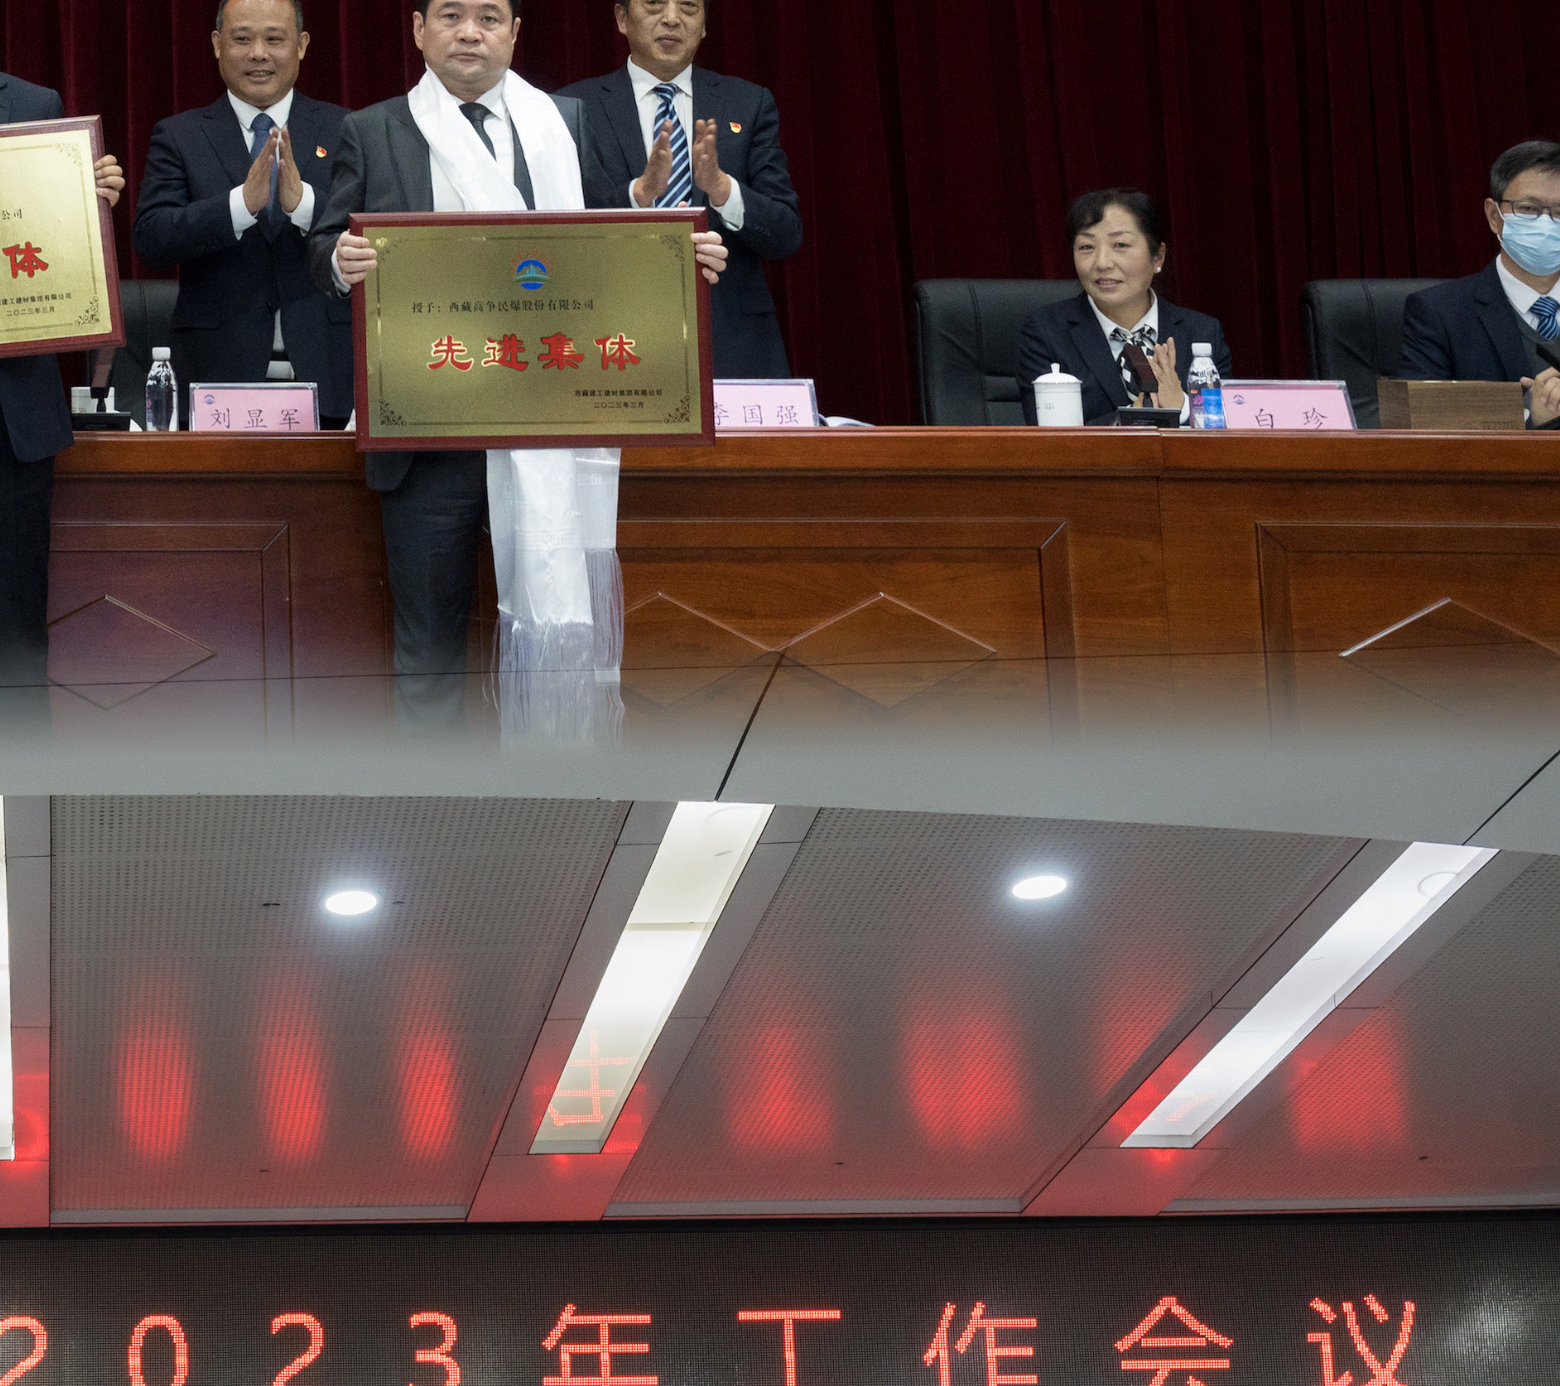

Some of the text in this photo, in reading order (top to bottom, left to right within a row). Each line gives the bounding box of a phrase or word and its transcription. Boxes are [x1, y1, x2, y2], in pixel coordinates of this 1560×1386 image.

[427, 332, 641, 372] 先进集体
[210, 408, 301, 431] 刘显军
